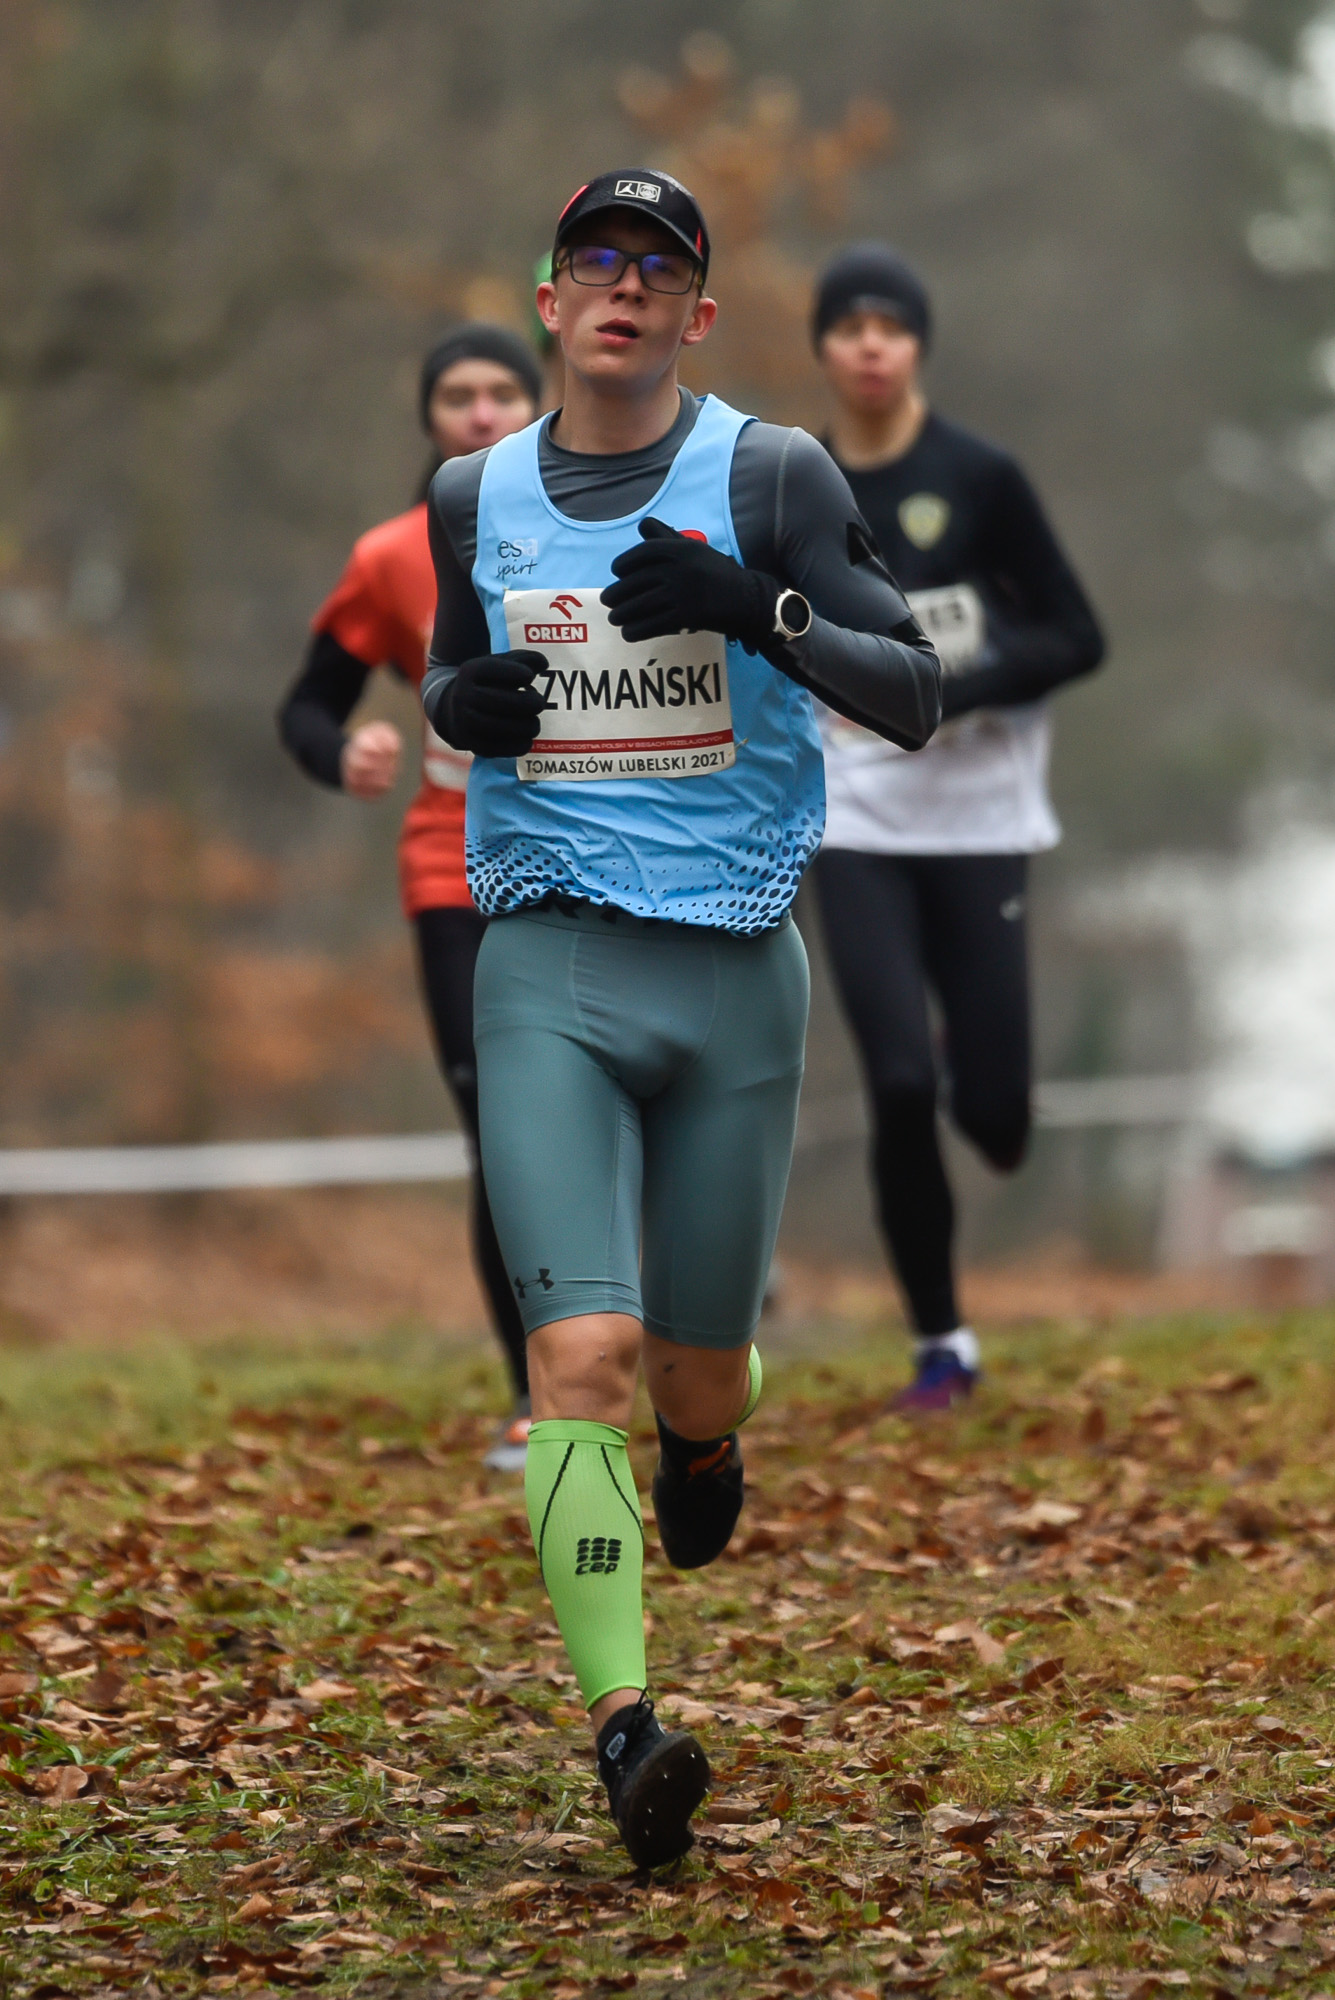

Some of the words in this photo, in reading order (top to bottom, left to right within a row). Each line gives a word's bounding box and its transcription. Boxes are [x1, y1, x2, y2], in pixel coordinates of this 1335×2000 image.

[528, 626, 584, 641] ORLEN
[539, 658, 722, 711] ZYMAŃSKI
[525, 756, 613, 774] TOMASZÓW
[618, 757, 686, 773] LUBELSKI
[691, 751, 726, 769] 2021
